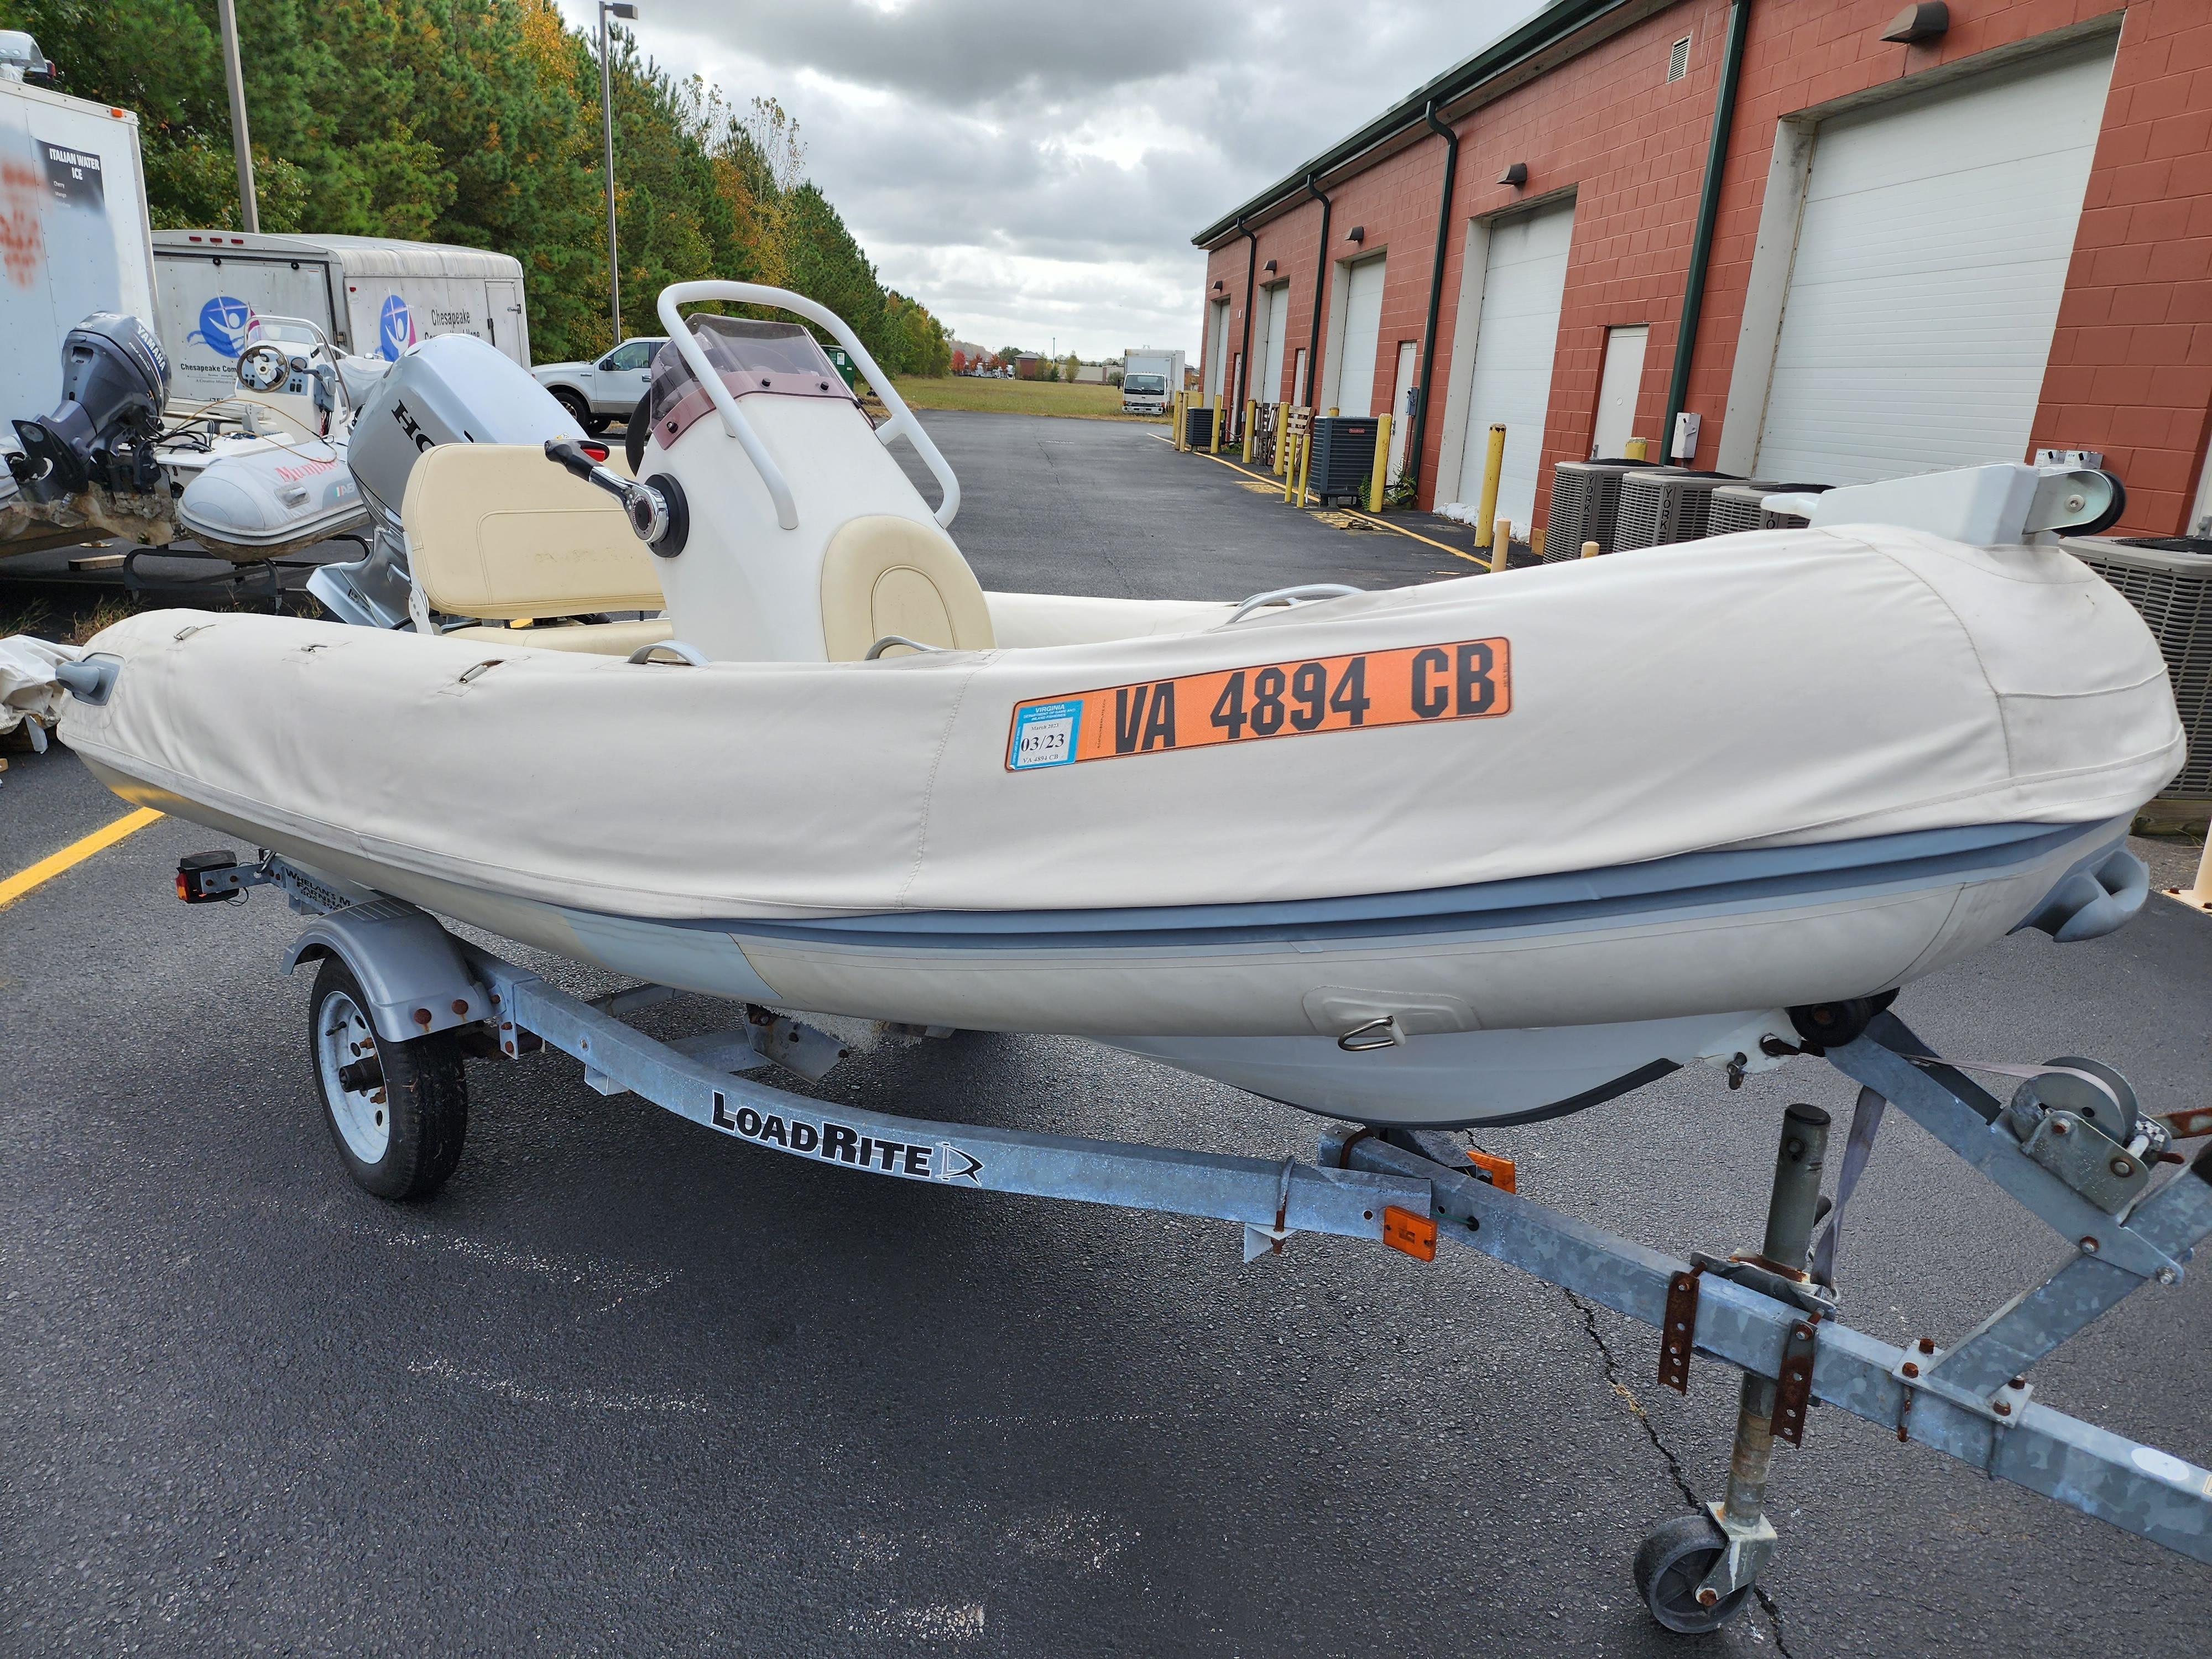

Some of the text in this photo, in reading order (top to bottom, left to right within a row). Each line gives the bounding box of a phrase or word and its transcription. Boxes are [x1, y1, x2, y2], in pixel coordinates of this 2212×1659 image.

[49, 148, 100, 171] ITALIAN WATER
[71, 166, 83, 180] ICE
[431, 308, 470, 329] Chesapeake
[138, 325, 166, 372] YAMAHA
[180, 363, 221, 373] Chesapeake
[1584, 476, 1594, 513] YORK
[1660, 488, 1673, 530] YORK
[1035, 704, 1065, 713] VIRGINIA
[1115, 642, 1495, 755] VA 4894 CB
[1021, 733, 1065, 752] 03/23
[285, 868, 336, 900] WHELAN'S
